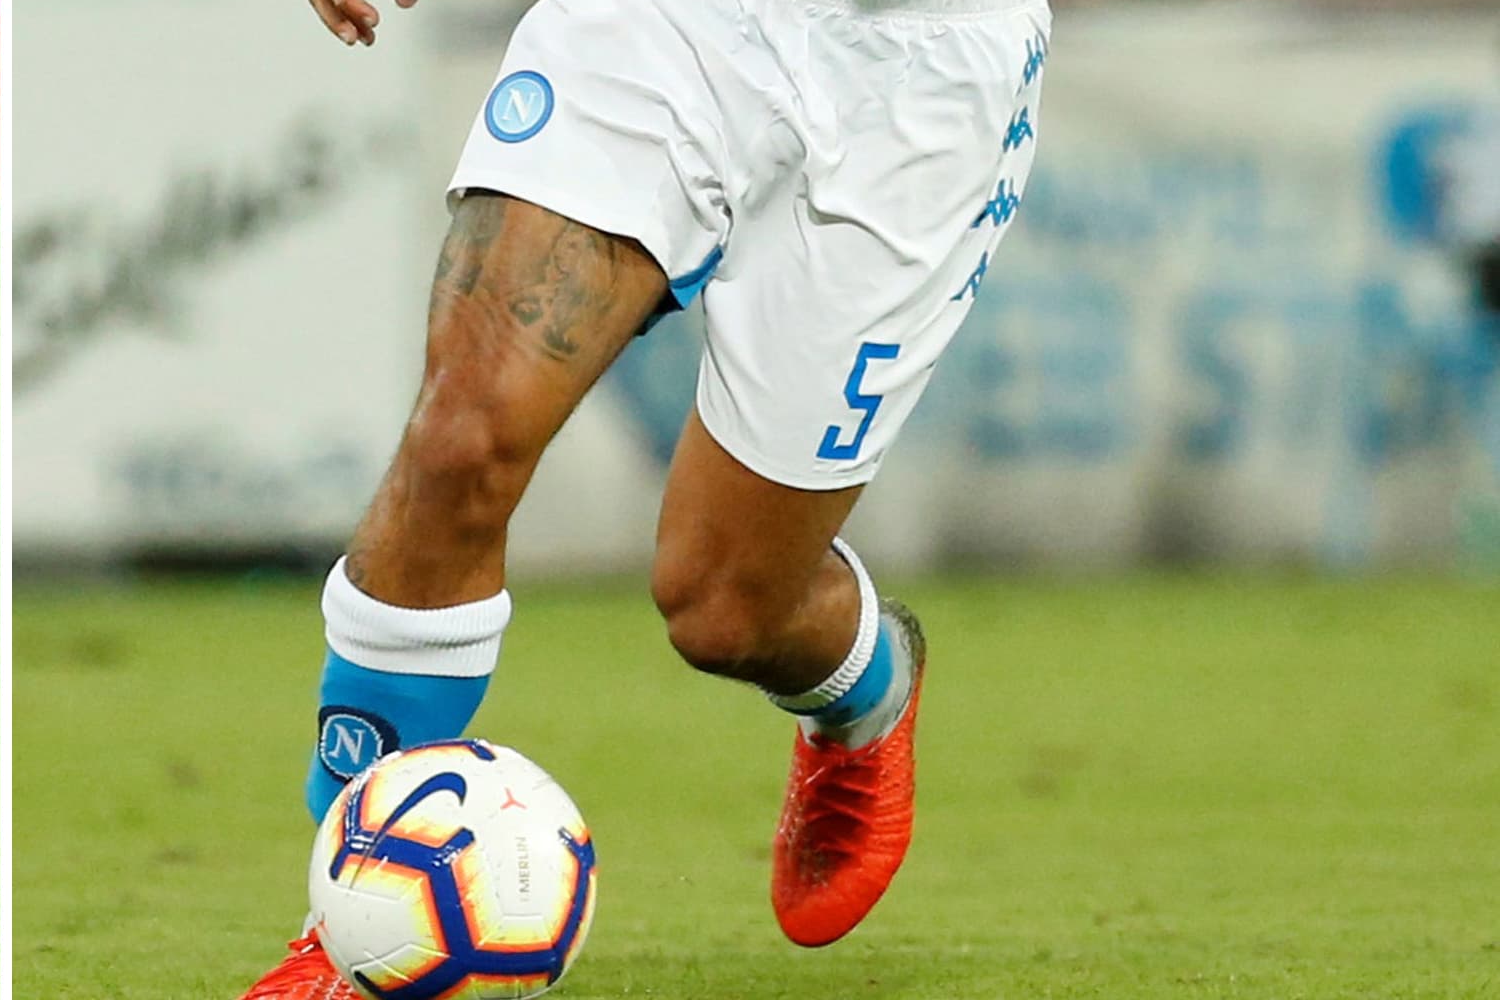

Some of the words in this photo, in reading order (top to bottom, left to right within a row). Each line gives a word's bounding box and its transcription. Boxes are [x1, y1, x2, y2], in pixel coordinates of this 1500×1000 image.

[501, 87, 538, 126] N
[816, 342, 901, 461] 5
[328, 722, 366, 766] N
[515, 835, 530, 893] MERLIN
